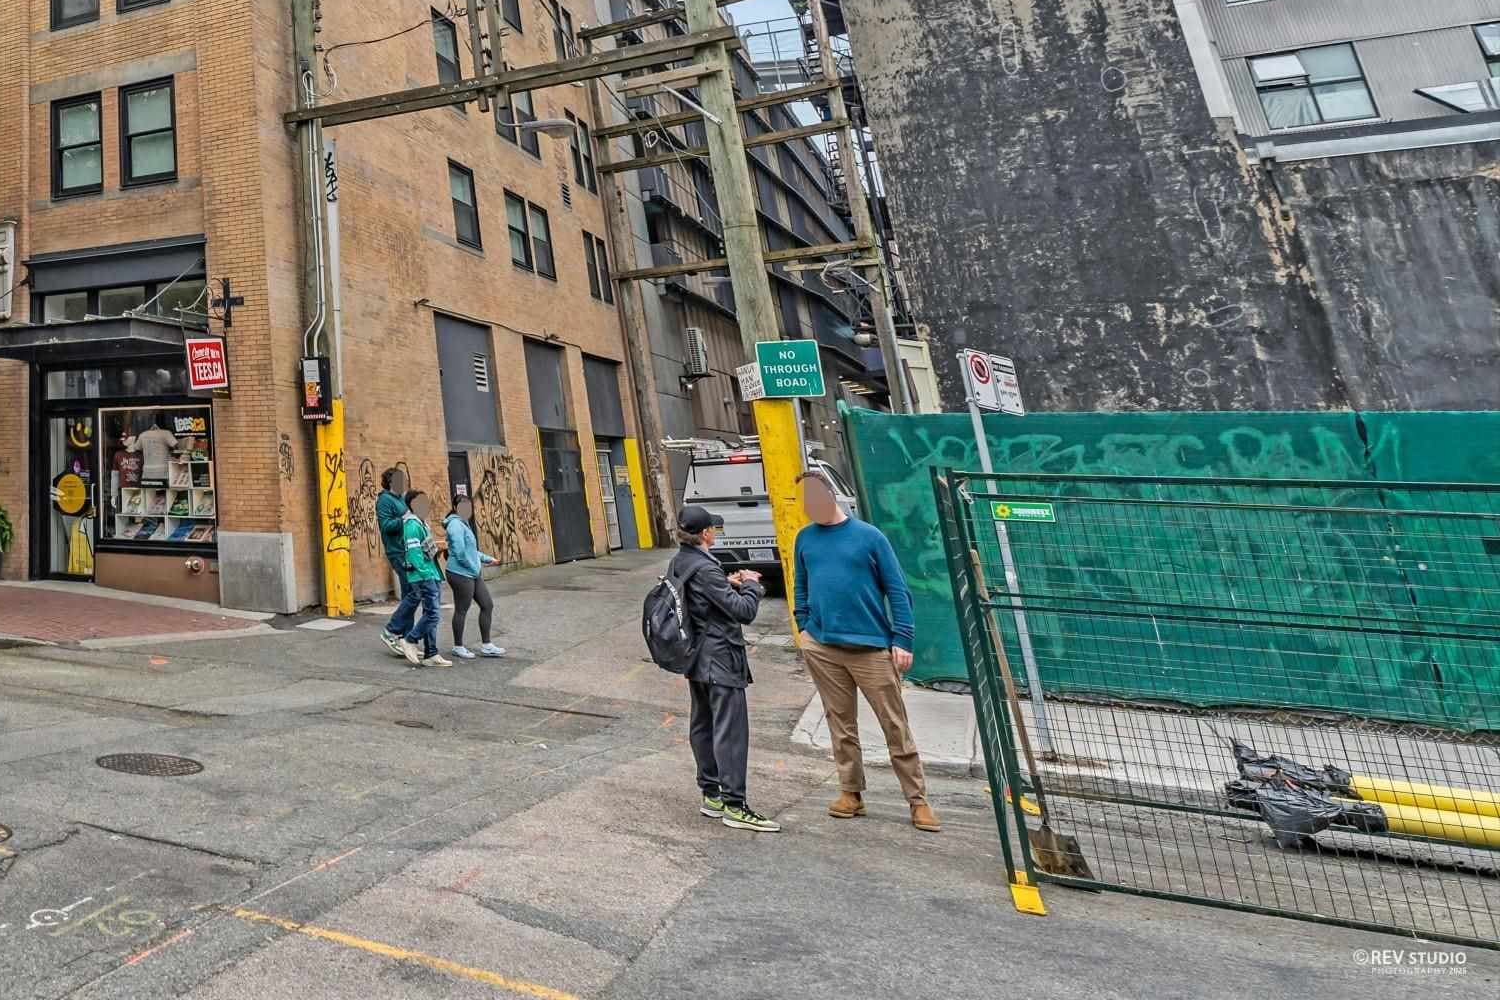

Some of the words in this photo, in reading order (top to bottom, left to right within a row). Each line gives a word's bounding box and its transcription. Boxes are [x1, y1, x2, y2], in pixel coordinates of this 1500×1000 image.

[778, 350, 796, 360] NO
[193, 361, 224, 381] TEES.CA
[763, 364, 818, 375] THROUGH
[775, 377, 808, 388] ROAD
